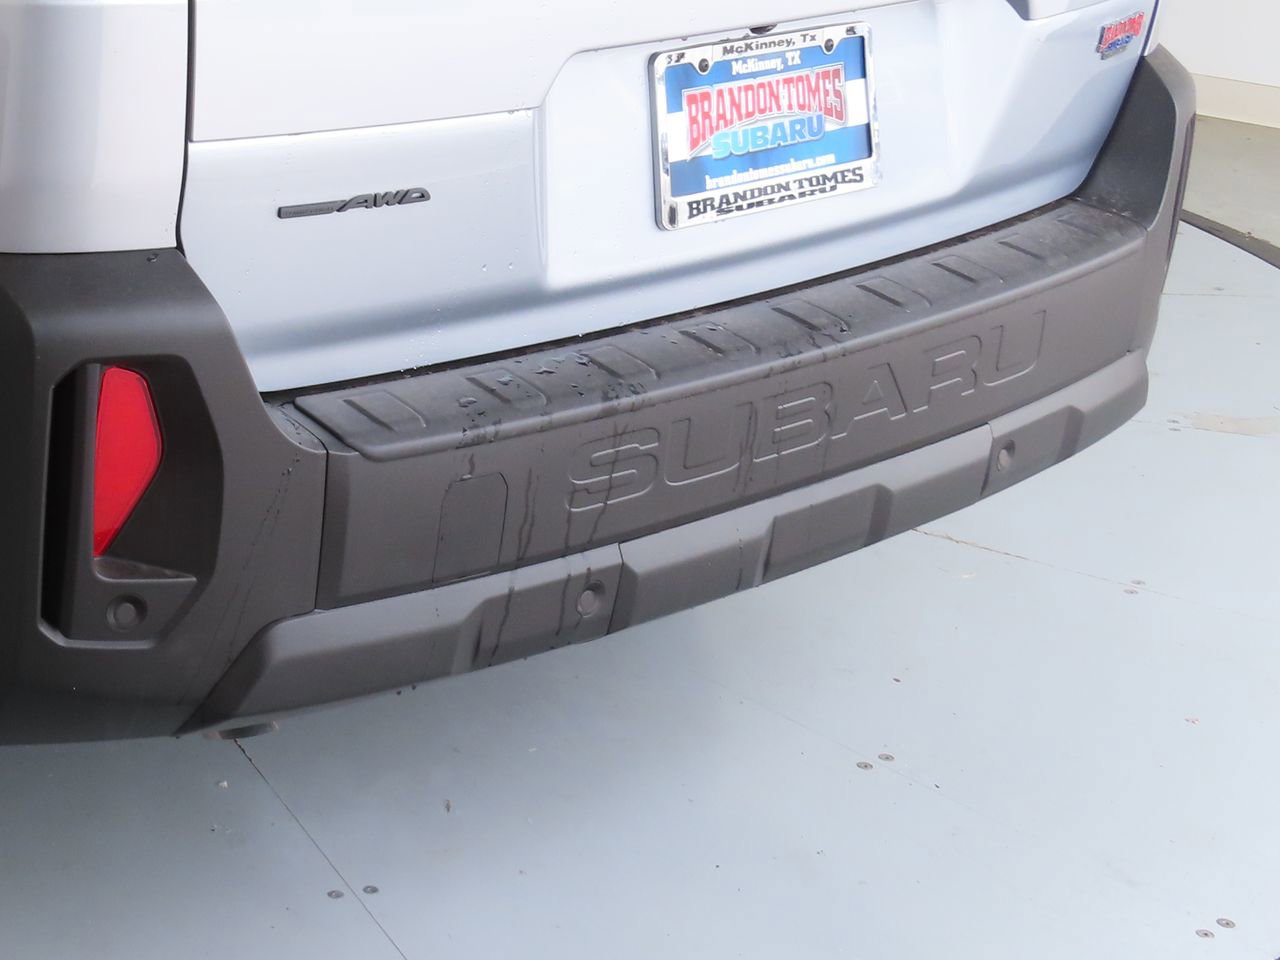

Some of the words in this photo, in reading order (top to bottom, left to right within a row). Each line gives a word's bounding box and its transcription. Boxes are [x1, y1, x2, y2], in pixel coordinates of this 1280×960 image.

[722, 38, 796, 57] McKinney,
[800, 33, 817, 44] Tx
[731, 57, 784, 76] McKinney,
[785, 50, 801, 66] TX
[686, 79, 781, 152] BRANDON
[782, 67, 844, 123] TOMES
[712, 114, 826, 159] SUBARU
[336, 187, 432, 213] AWD
[687, 182, 791, 220] BRANDON
[792, 166, 864, 193] TOMES
[716, 185, 838, 217] SUBARU
[562, 309, 1048, 514] SUBARU
